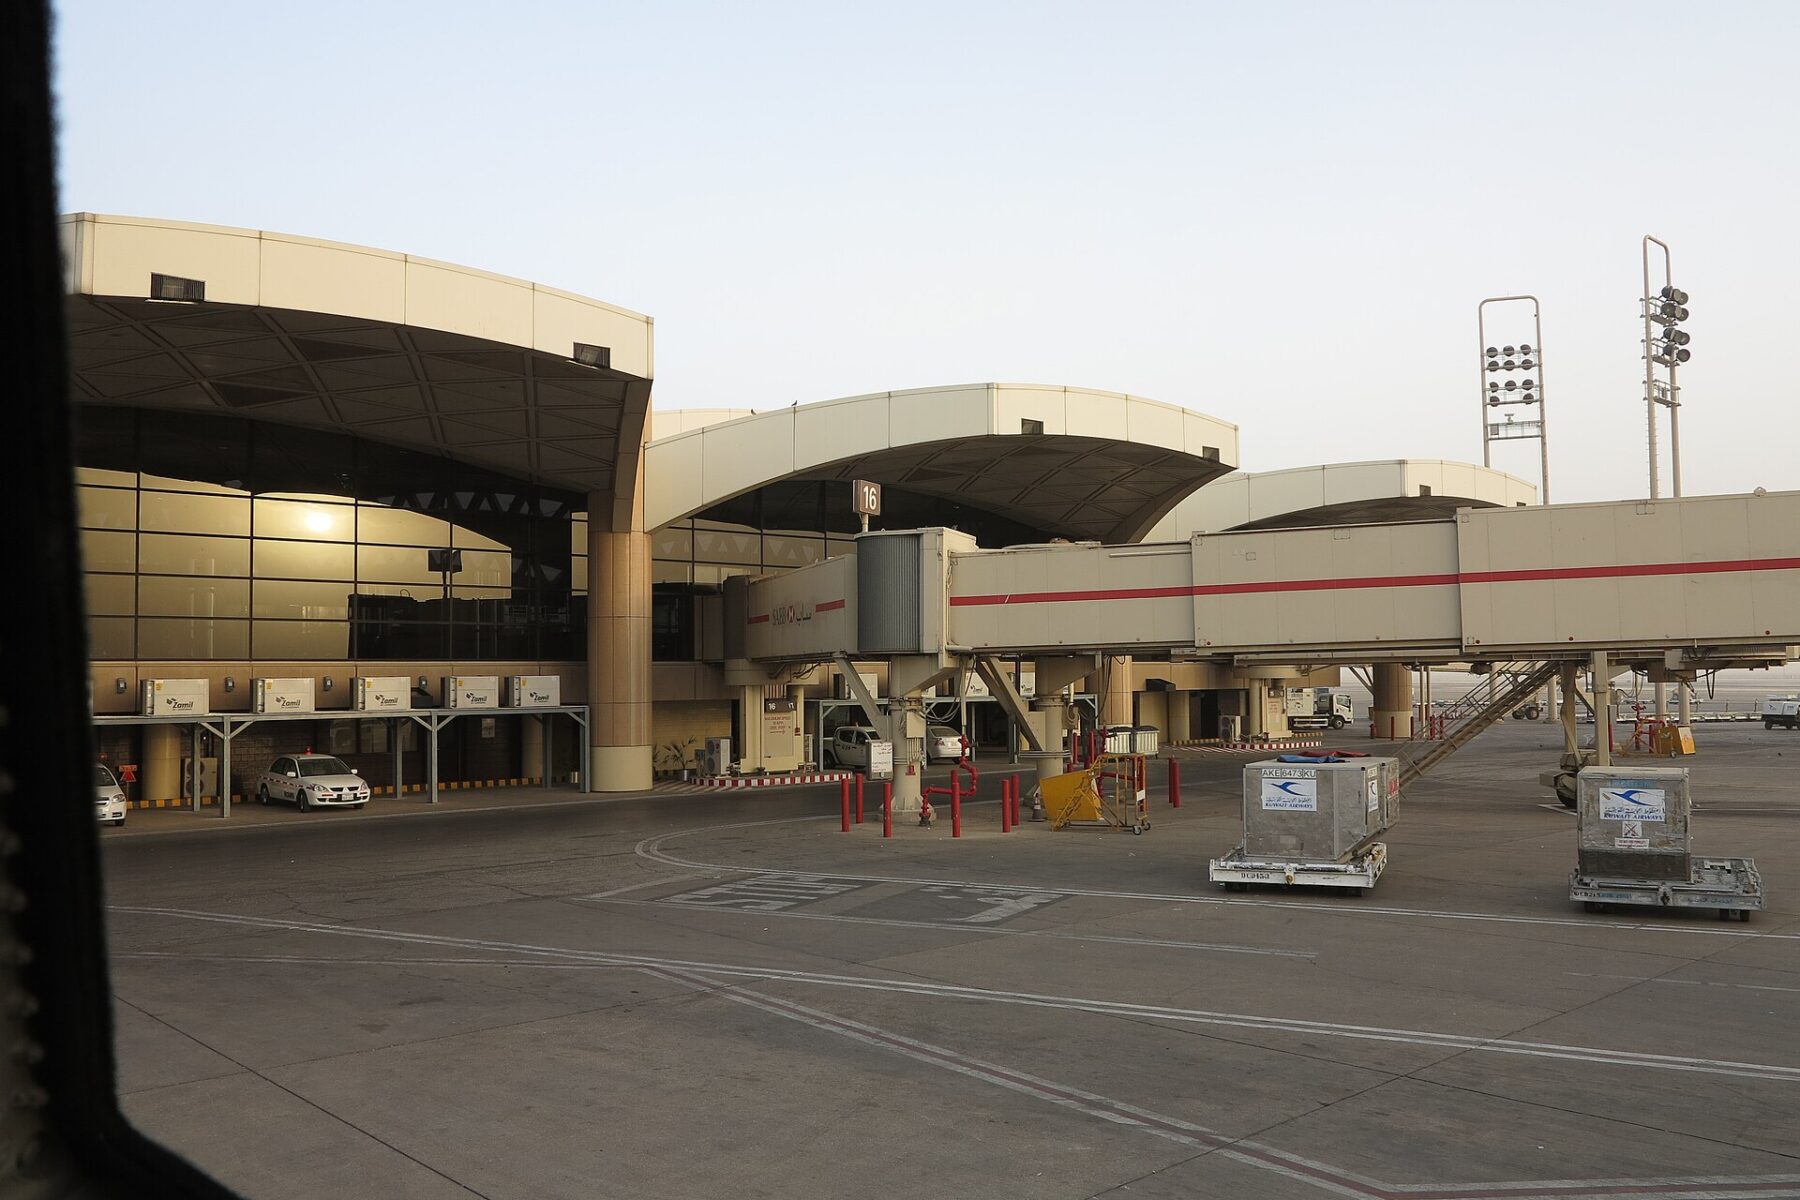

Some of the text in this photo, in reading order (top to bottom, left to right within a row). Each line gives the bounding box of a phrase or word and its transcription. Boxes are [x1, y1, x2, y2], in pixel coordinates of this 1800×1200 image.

[863, 485, 877, 510] 16
[172, 701, 193, 709] Zamil
[768, 702, 776, 711] 16
[1262, 769, 1280, 777] AKE
[1303, 770, 1316, 778] KU
